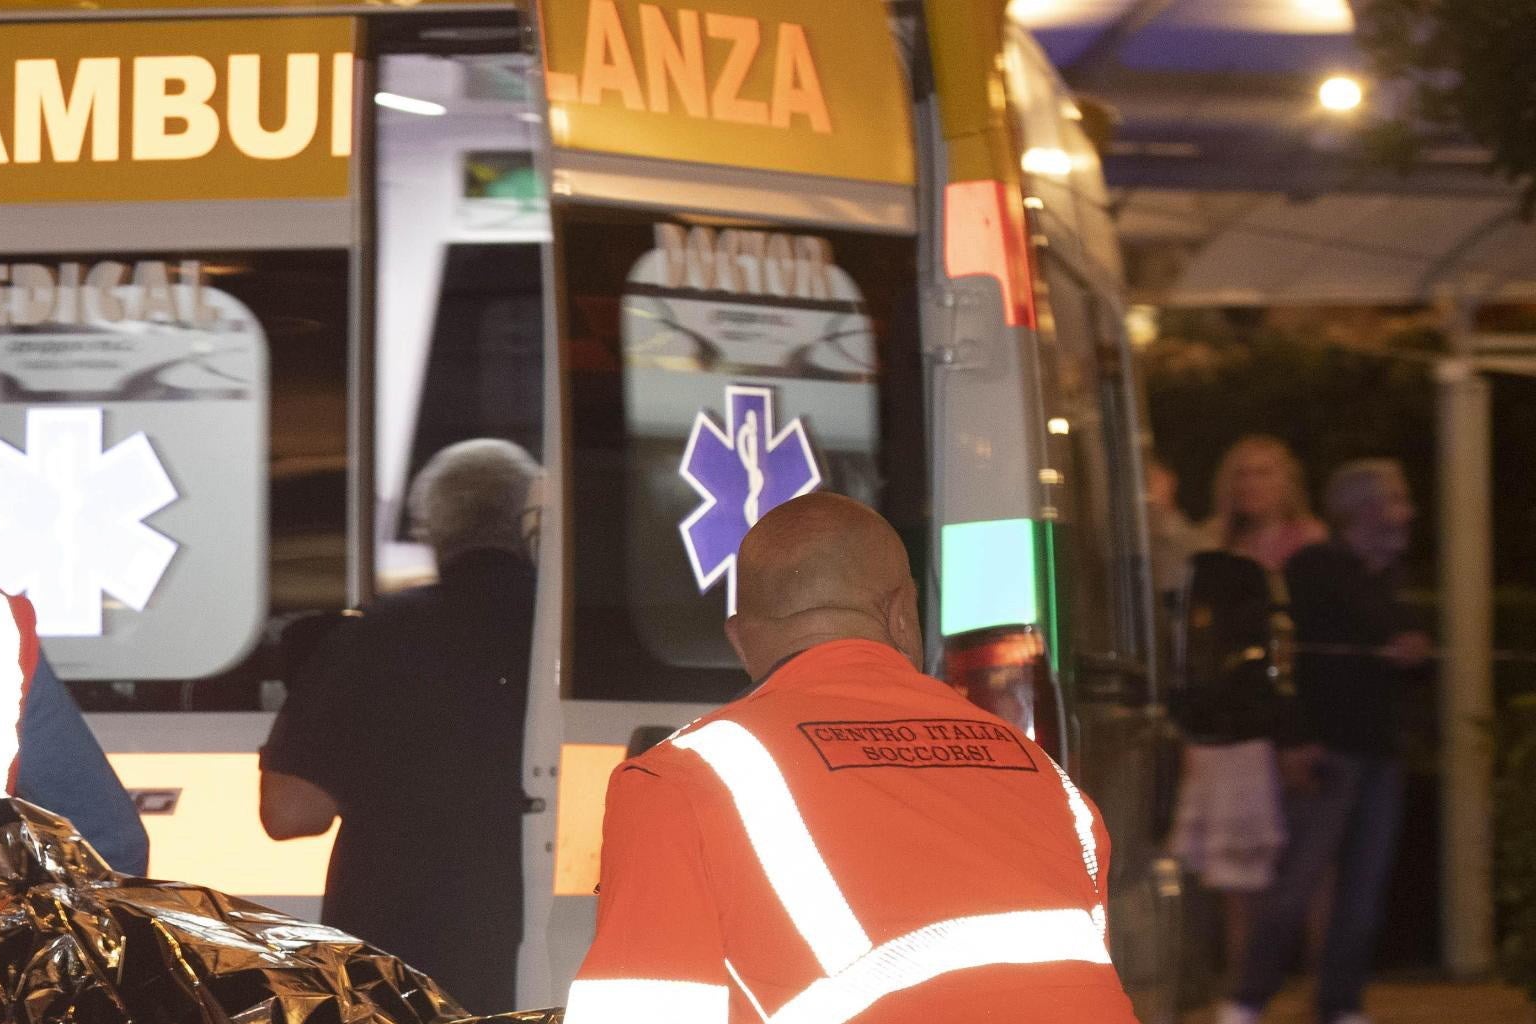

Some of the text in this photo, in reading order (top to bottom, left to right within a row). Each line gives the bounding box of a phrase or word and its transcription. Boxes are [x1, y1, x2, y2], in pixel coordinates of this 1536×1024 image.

[547, 0, 833, 134] ANZA
[814, 725, 1014, 744] CENTRO ITALIA
[862, 744, 996, 762] SOCCORSI
